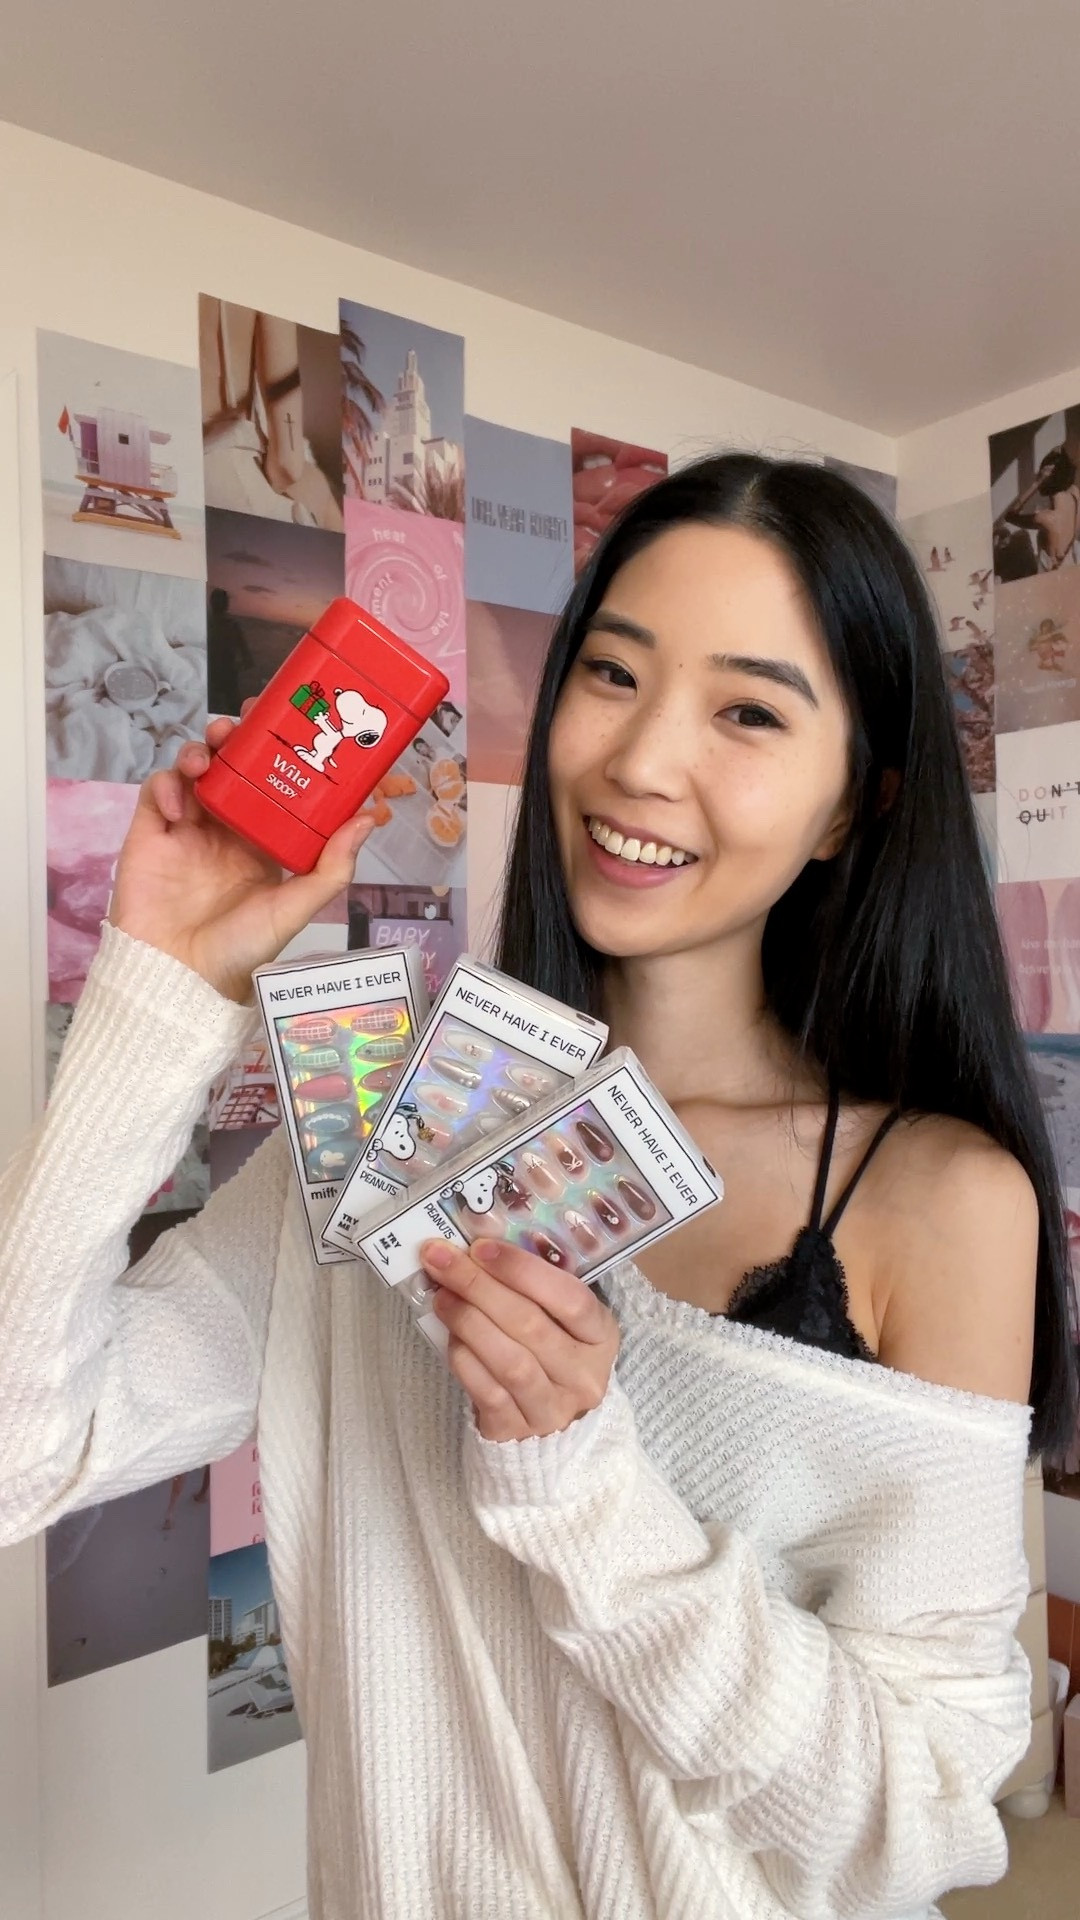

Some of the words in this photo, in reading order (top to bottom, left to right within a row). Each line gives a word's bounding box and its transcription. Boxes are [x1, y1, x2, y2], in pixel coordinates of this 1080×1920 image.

[372, 528, 406, 544] heat
[434, 564, 448, 581] of
[431, 610, 449, 636] the
[273, 753, 311, 790] Wild
[265, 773, 298, 799] SNOOPY
[1017, 806, 1067, 826] QUIT
[269, 985, 313, 1002] NEVER
[316, 979, 352, 995] HAVE
[355, 977, 362, 989] I
[366, 971, 401, 987] EVER
[455, 987, 501, 1018] NEVER
[502, 1011, 539, 1037] HAVE
[539, 1030, 550, 1042] I
[549, 1035, 587, 1061] EVER
[607, 1085, 643, 1129] NEVER
[638, 1127, 668, 1164] HAVE
[662, 1162, 675, 1173] I
[669, 1171, 698, 1206] EVER
[360, 1170, 397, 1196] PEANUTS
[337, 1221, 351, 1231] ME
[343, 1213, 359, 1226] TRY
[424, 1203, 453, 1240] PEANUTS
[379, 1237, 392, 1250] ME
[387, 1232, 402, 1248] TRY
